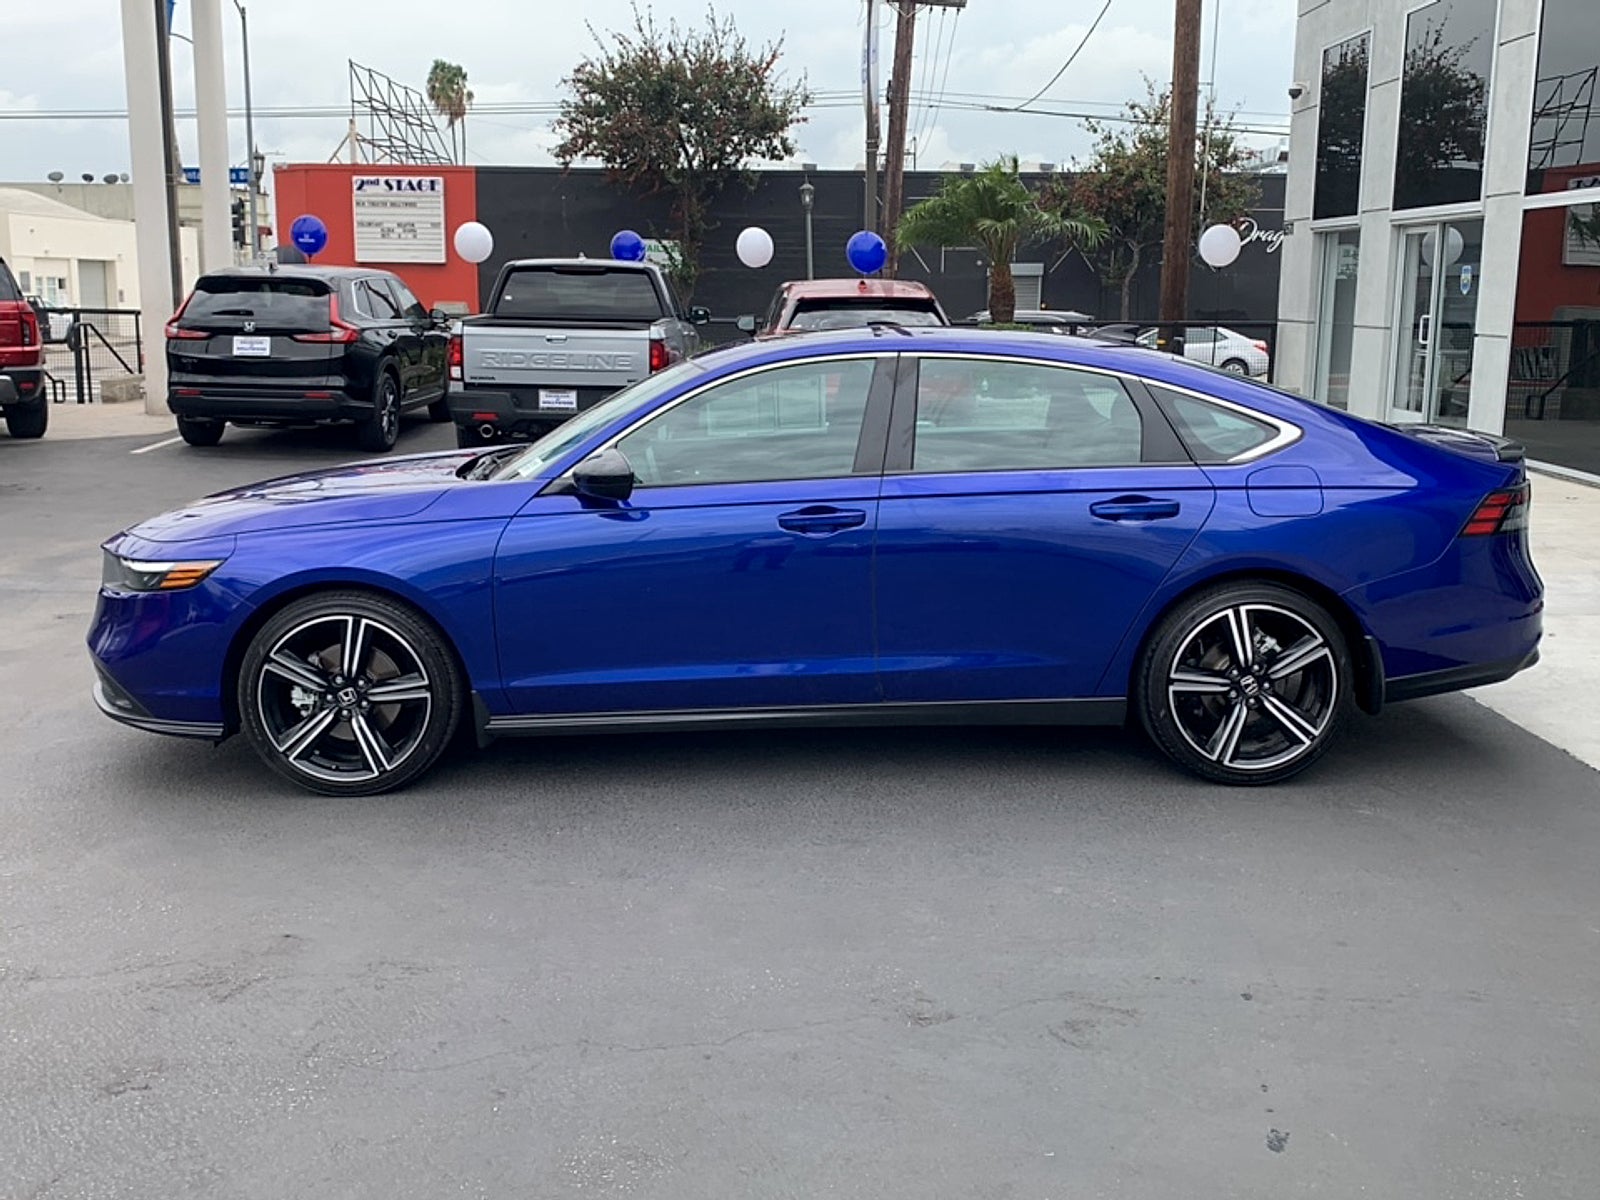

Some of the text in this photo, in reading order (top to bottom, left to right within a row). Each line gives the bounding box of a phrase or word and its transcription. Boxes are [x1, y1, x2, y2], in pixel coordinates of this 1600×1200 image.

[355, 178, 440, 191] 2nd STAGE
[480, 352, 633, 370] RIDGELINE
